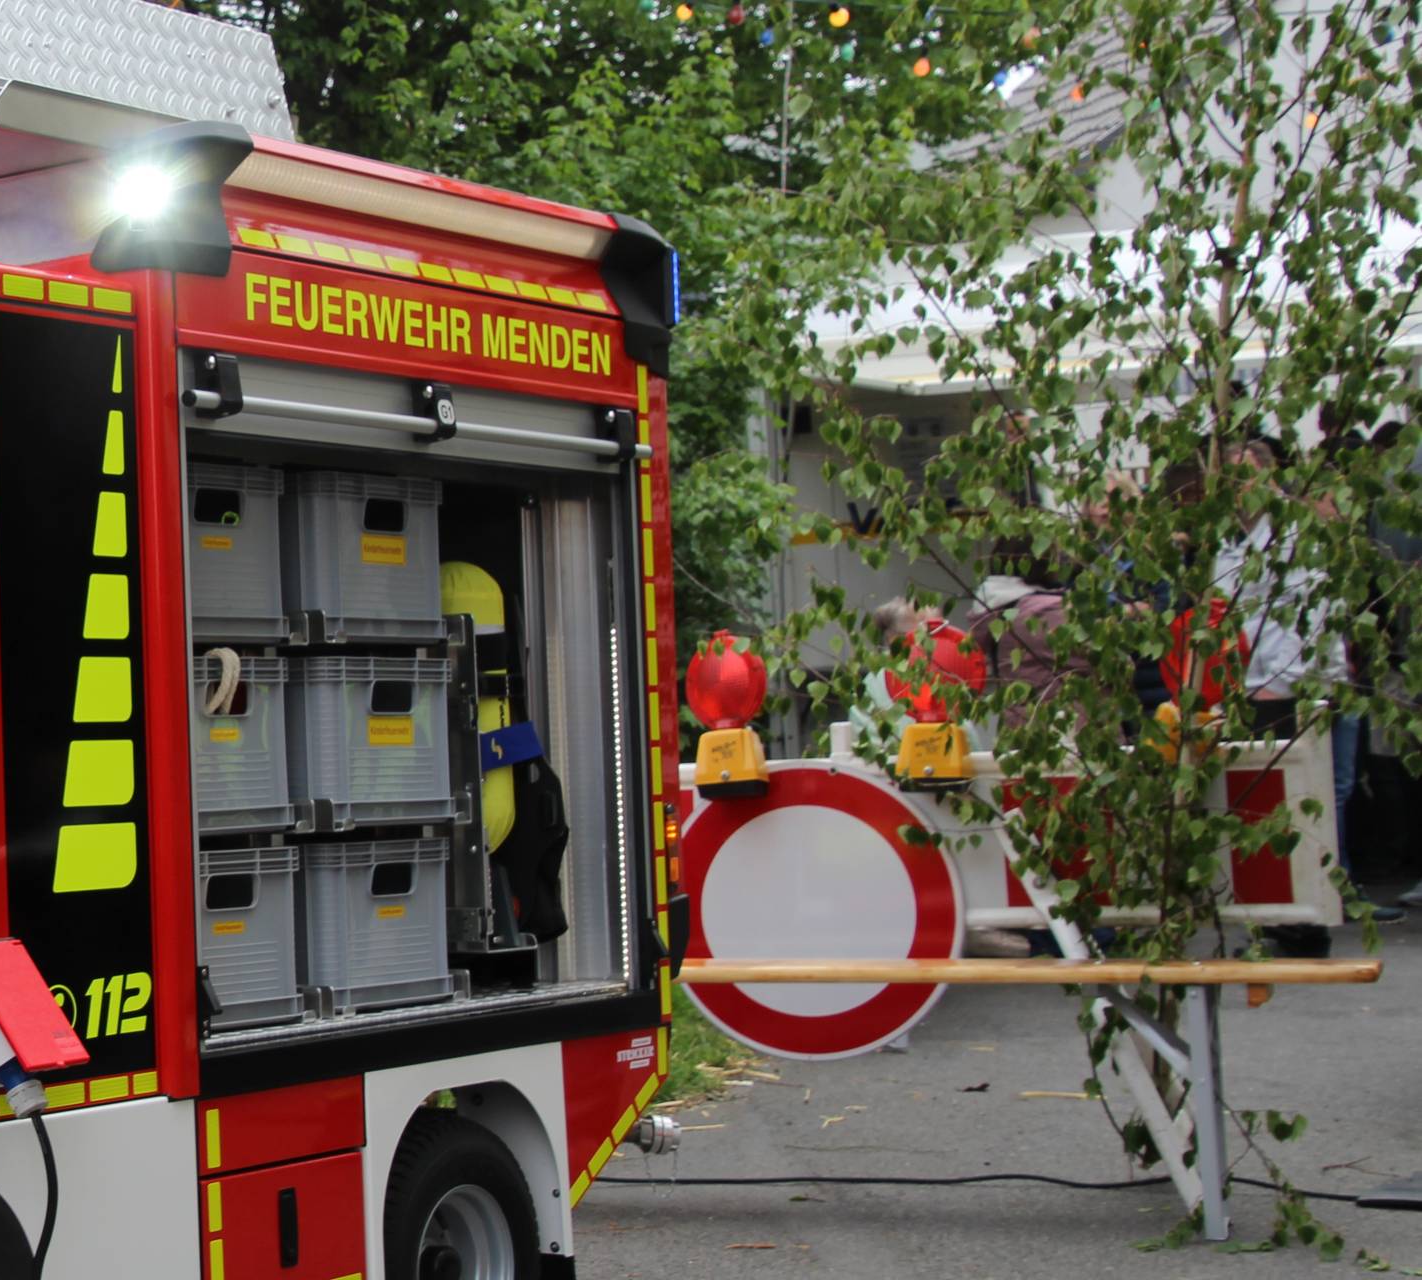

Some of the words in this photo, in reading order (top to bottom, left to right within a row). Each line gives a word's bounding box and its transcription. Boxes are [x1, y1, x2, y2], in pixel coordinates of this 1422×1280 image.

[245, 272, 472, 355] FEUERWEHR
[482, 313, 611, 376] MENDEN
[85, 971, 153, 1039] 112
